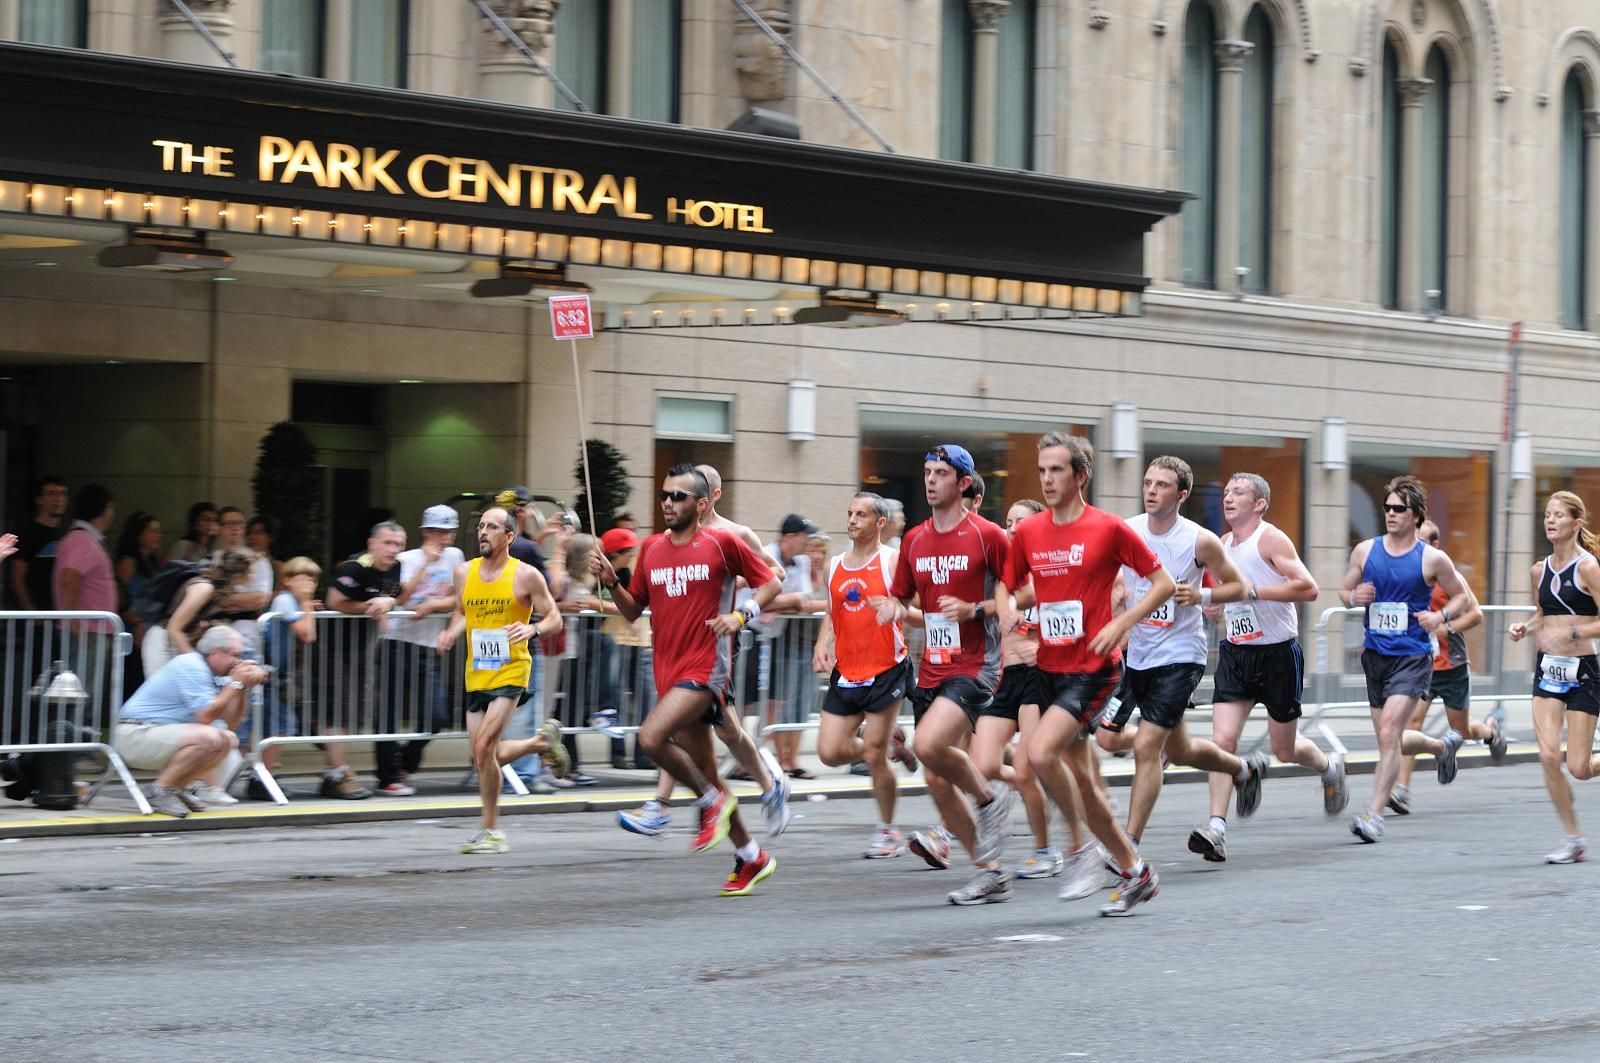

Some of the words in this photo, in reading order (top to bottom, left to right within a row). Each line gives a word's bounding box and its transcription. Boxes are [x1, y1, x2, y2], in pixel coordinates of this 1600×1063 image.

[152, 139, 235, 178] THE
[257, 135, 405, 195] PARK
[407, 154, 653, 220] CENTRAL
[666, 197, 774, 234] HOTEL
[916, 556, 937, 573] NIKE
[938, 555, 969, 571] PACER
[651, 567, 674, 586] NIKE
[675, 564, 710, 581] PACER
[931, 569, 950, 585] 6:51
[466, 598, 489, 606] FLEET
[491, 598, 512, 606] FEET
[1047, 616, 1076, 636] 1923
[1231, 617, 1254, 636] 1963
[1377, 613, 1398, 629] 749
[930, 627, 952, 646] 1975
[480, 640, 500, 658] 934
[1550, 665, 1567, 681] 991
